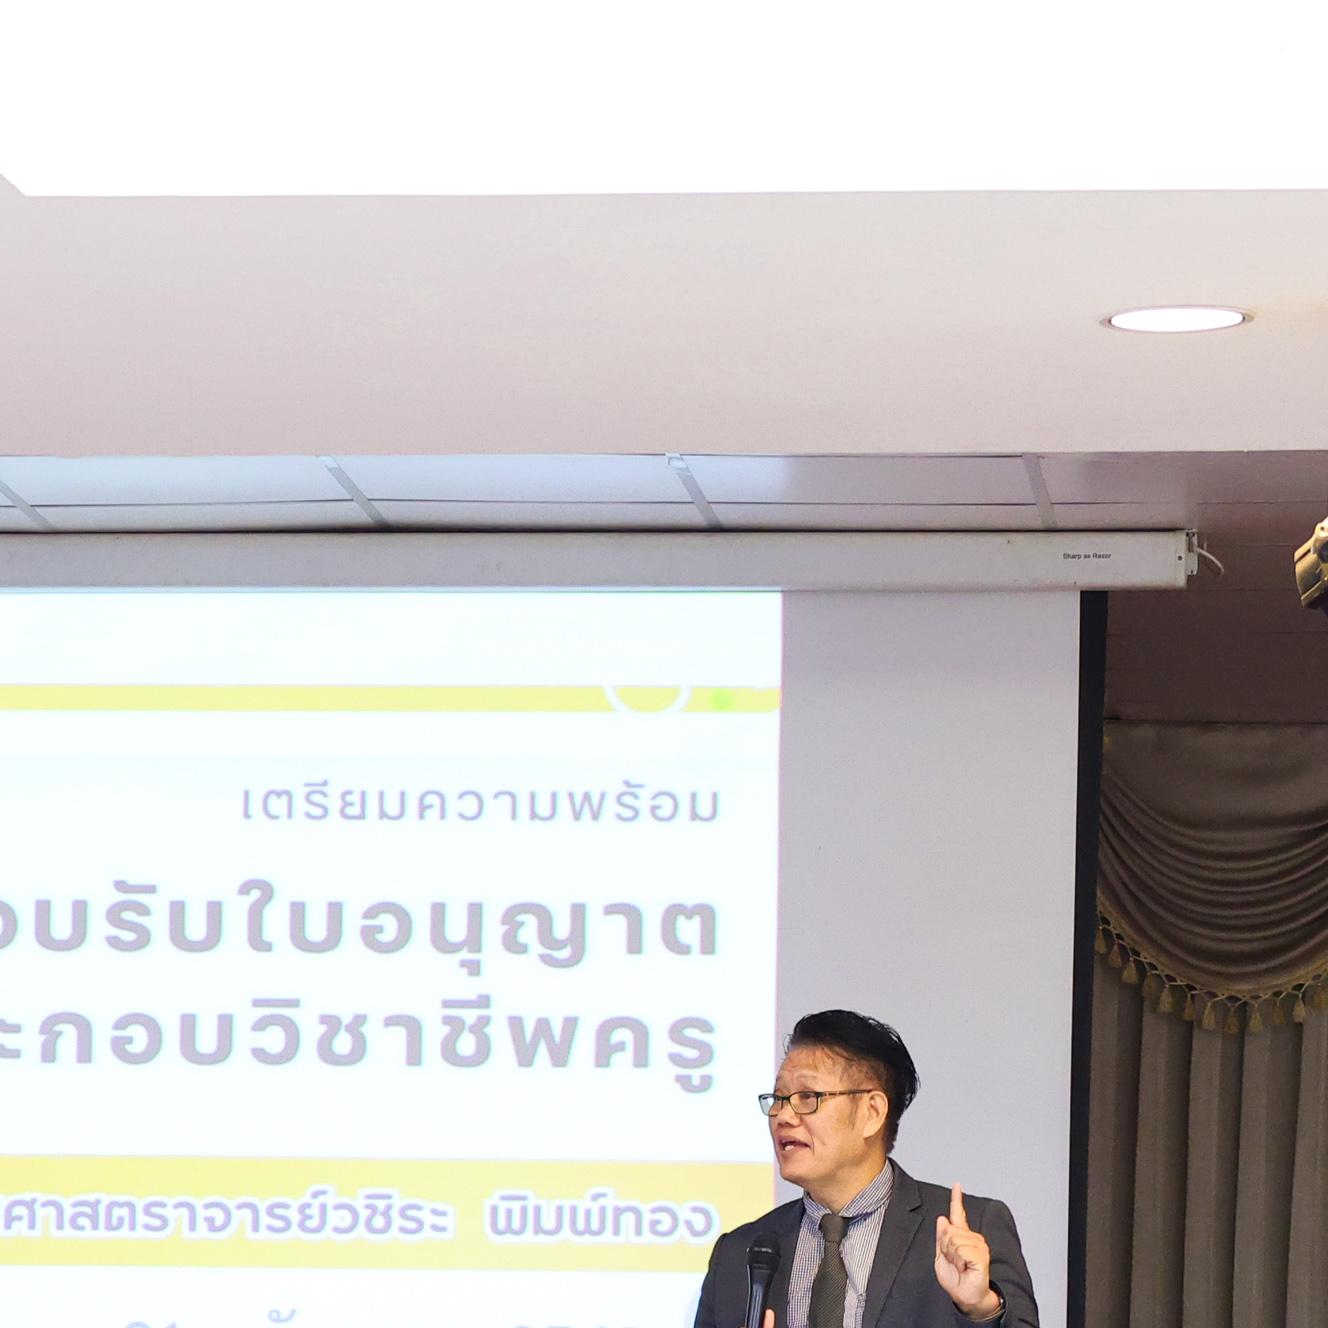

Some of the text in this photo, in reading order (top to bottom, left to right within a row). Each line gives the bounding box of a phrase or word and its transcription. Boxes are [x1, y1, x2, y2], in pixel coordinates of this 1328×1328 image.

[241, 779, 719, 822] เตรียมความพร้อม
[488, 1192, 715, 1239] พิมพ์ทอง
